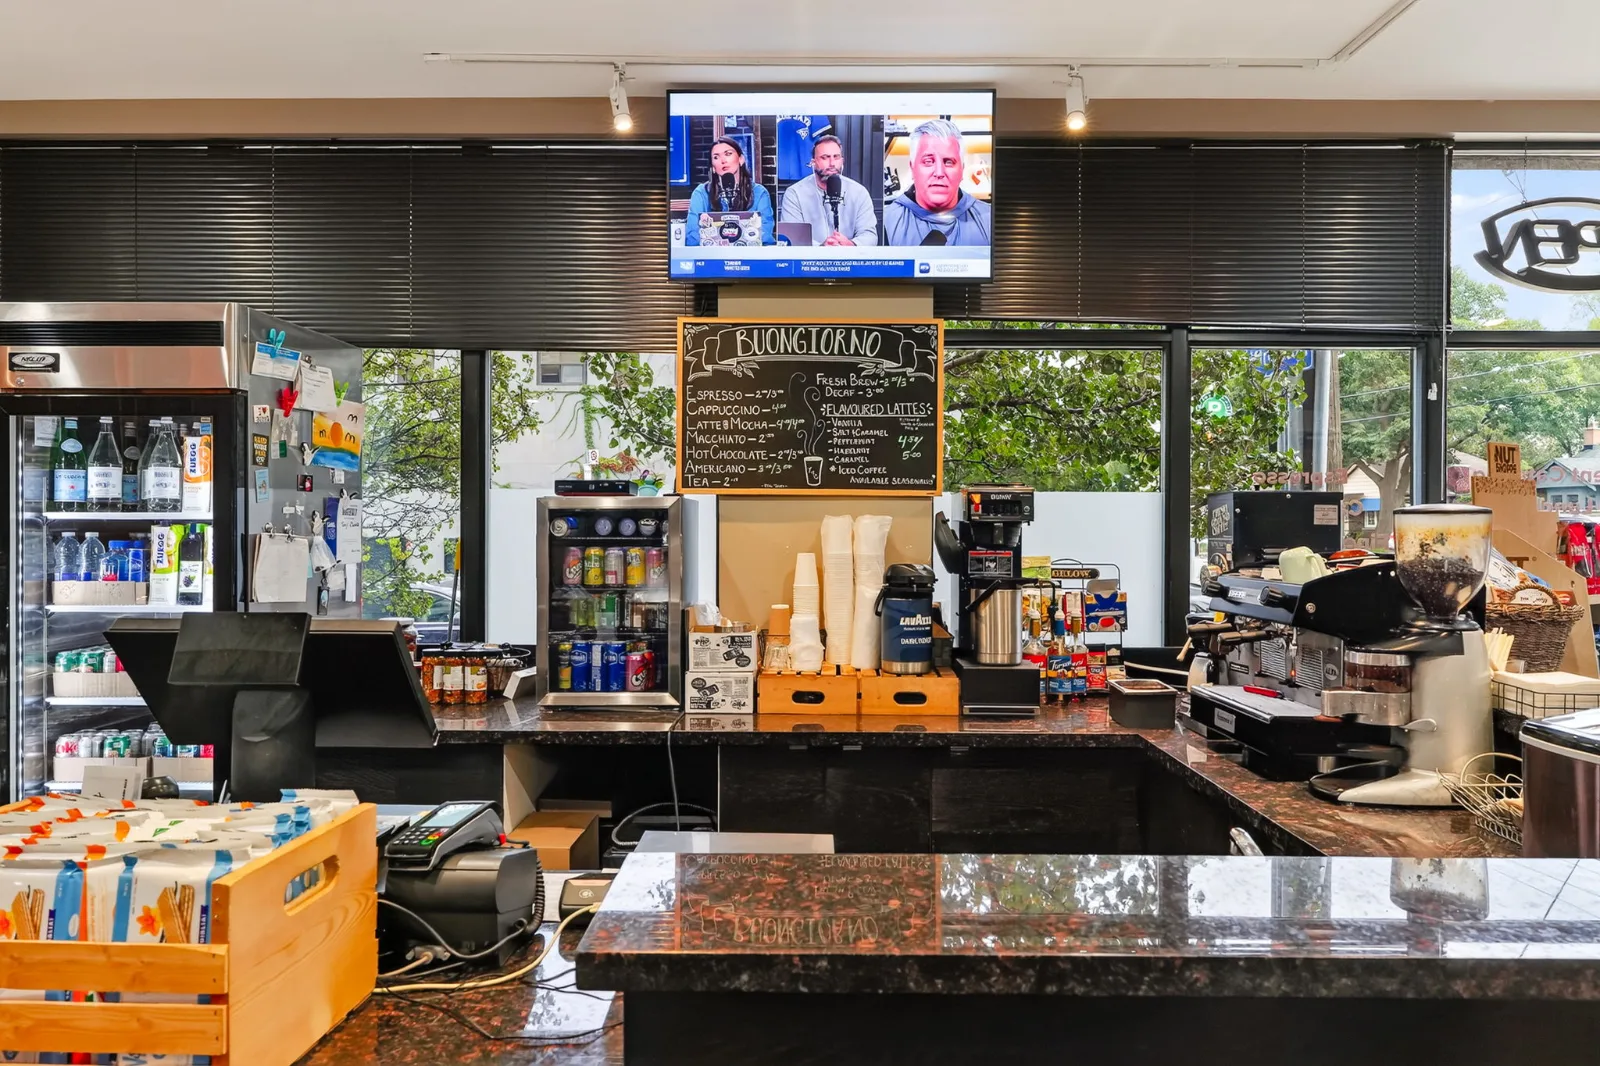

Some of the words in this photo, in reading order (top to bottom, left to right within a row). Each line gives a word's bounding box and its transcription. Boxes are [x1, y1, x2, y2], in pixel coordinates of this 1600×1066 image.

[736, 328, 881, 357] BUONGIORNO
[816, 373, 847, 386] FRESH
[850, 373, 878, 386] BREW
[686, 385, 743, 401] ESPRESSO
[825, 387, 855, 397] DECAF
[686, 400, 761, 415] CAPPUCCINO
[826, 403, 884, 416] FLAVOURED
[887, 402, 926, 415] LATTES
[686, 416, 721, 430] LATTE
[730, 417, 768, 430] MOCHA
[686, 431, 746, 444] MACCHIATO
[686, 446, 709, 459] HOT
[710, 445, 768, 460] CHOCOLATE
[1494, 445, 1516, 464] NUT
[685, 460, 746, 473] AMERICANO
[684, 474, 709, 487] TEA
